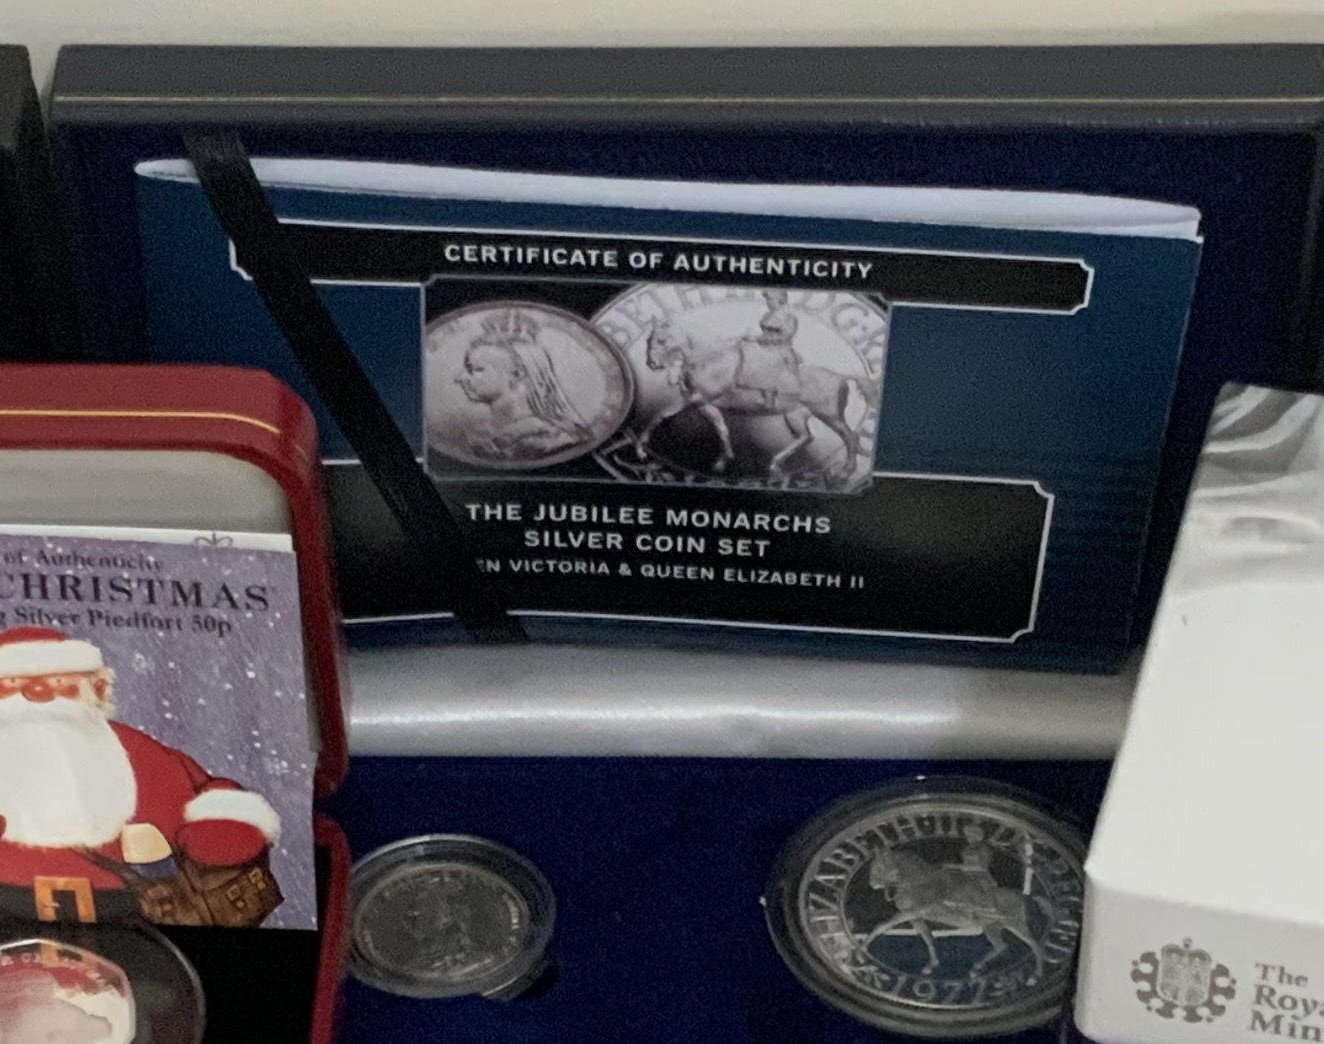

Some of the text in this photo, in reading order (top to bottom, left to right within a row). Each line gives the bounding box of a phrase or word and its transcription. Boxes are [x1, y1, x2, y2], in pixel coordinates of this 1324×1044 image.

[444, 244, 874, 279] CERTIFICATE OF AUTHENTICITY
[465, 503, 832, 535] THE JUBILEE MONARCHS
[2, 548, 26, 566] of
[35, 549, 165, 573] Authenticity
[524, 530, 772, 559] SILVER COIN SET
[509, 558, 611, 576] VICTORIA
[618, 562, 632, 577] &
[640, 563, 715, 582] QUEEN
[724, 567, 842, 589] ELIZABETH
[849, 575, 865, 590] II
[13, 604, 81, 627] Silver
[86, 607, 184, 633] Piedfort
[190, 614, 233, 638] 50p
[1253, 960, 1310, 990] The
